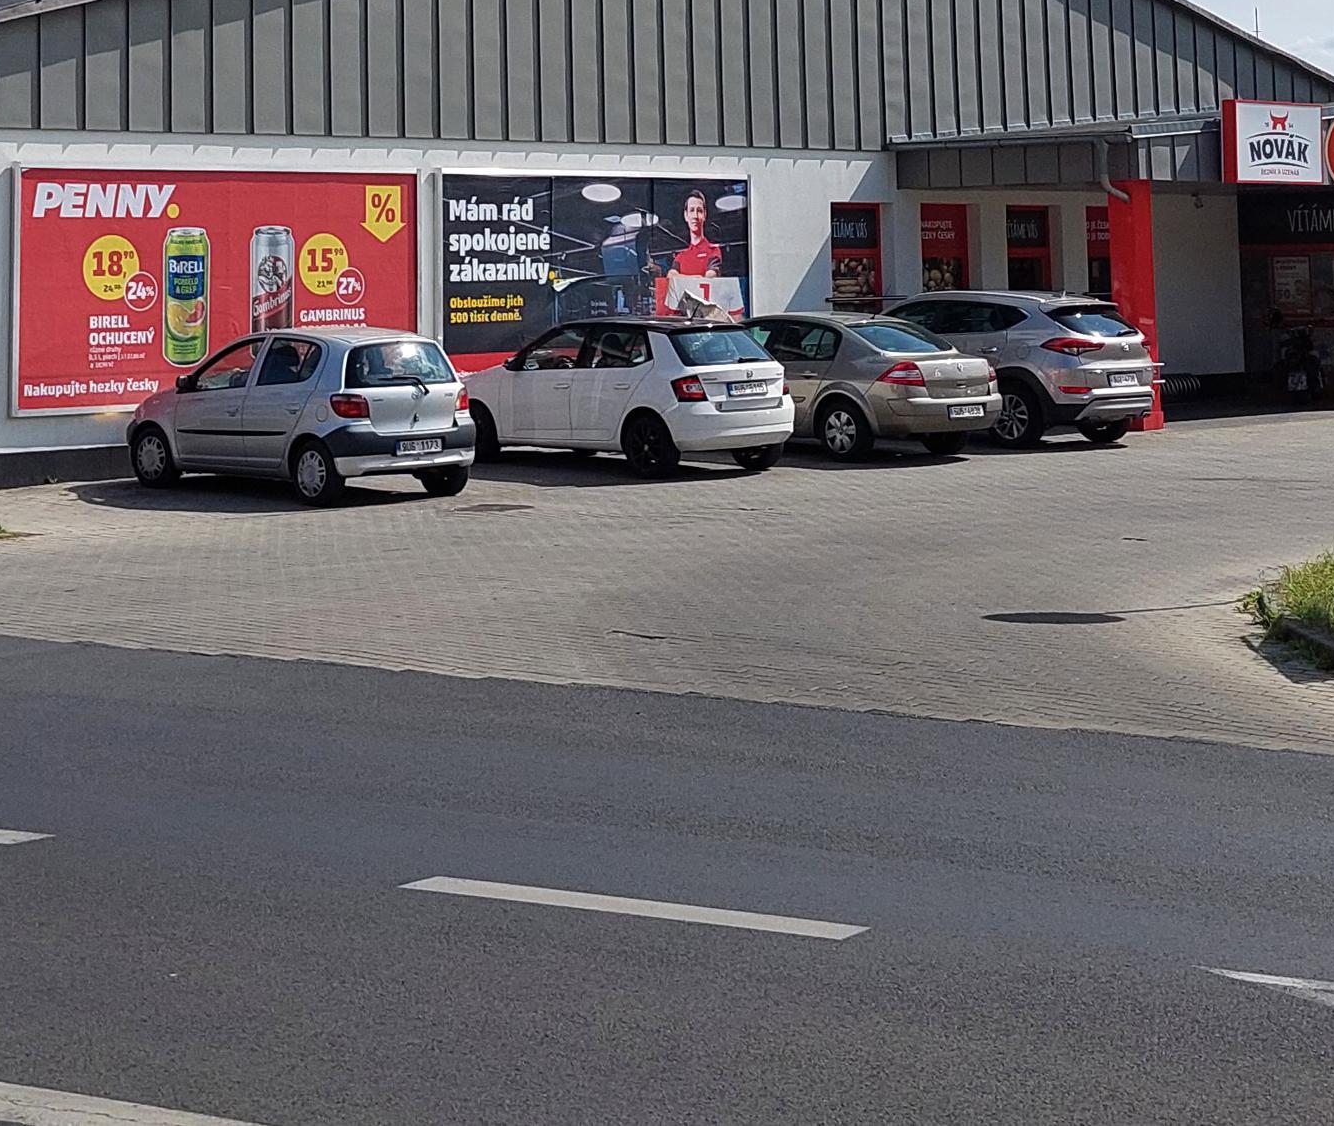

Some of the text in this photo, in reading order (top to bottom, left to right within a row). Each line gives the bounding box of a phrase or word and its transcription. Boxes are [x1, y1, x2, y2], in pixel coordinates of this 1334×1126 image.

[1249, 133, 1310, 165] NOVÁK
[449, 196, 534, 221] Mám rád
[449, 226, 551, 256] spokojené
[450, 294, 524, 309] Obsloužíme jich
[89, 315, 130, 329] BIRELL
[300, 307, 365, 320] GAMBRINUS
[450, 312, 468, 323] 500
[470, 310, 489, 323] tisíc
[89, 327, 155, 345] OCHUCENÝ
[24, 378, 159, 398] Nakupujte hezky česky
